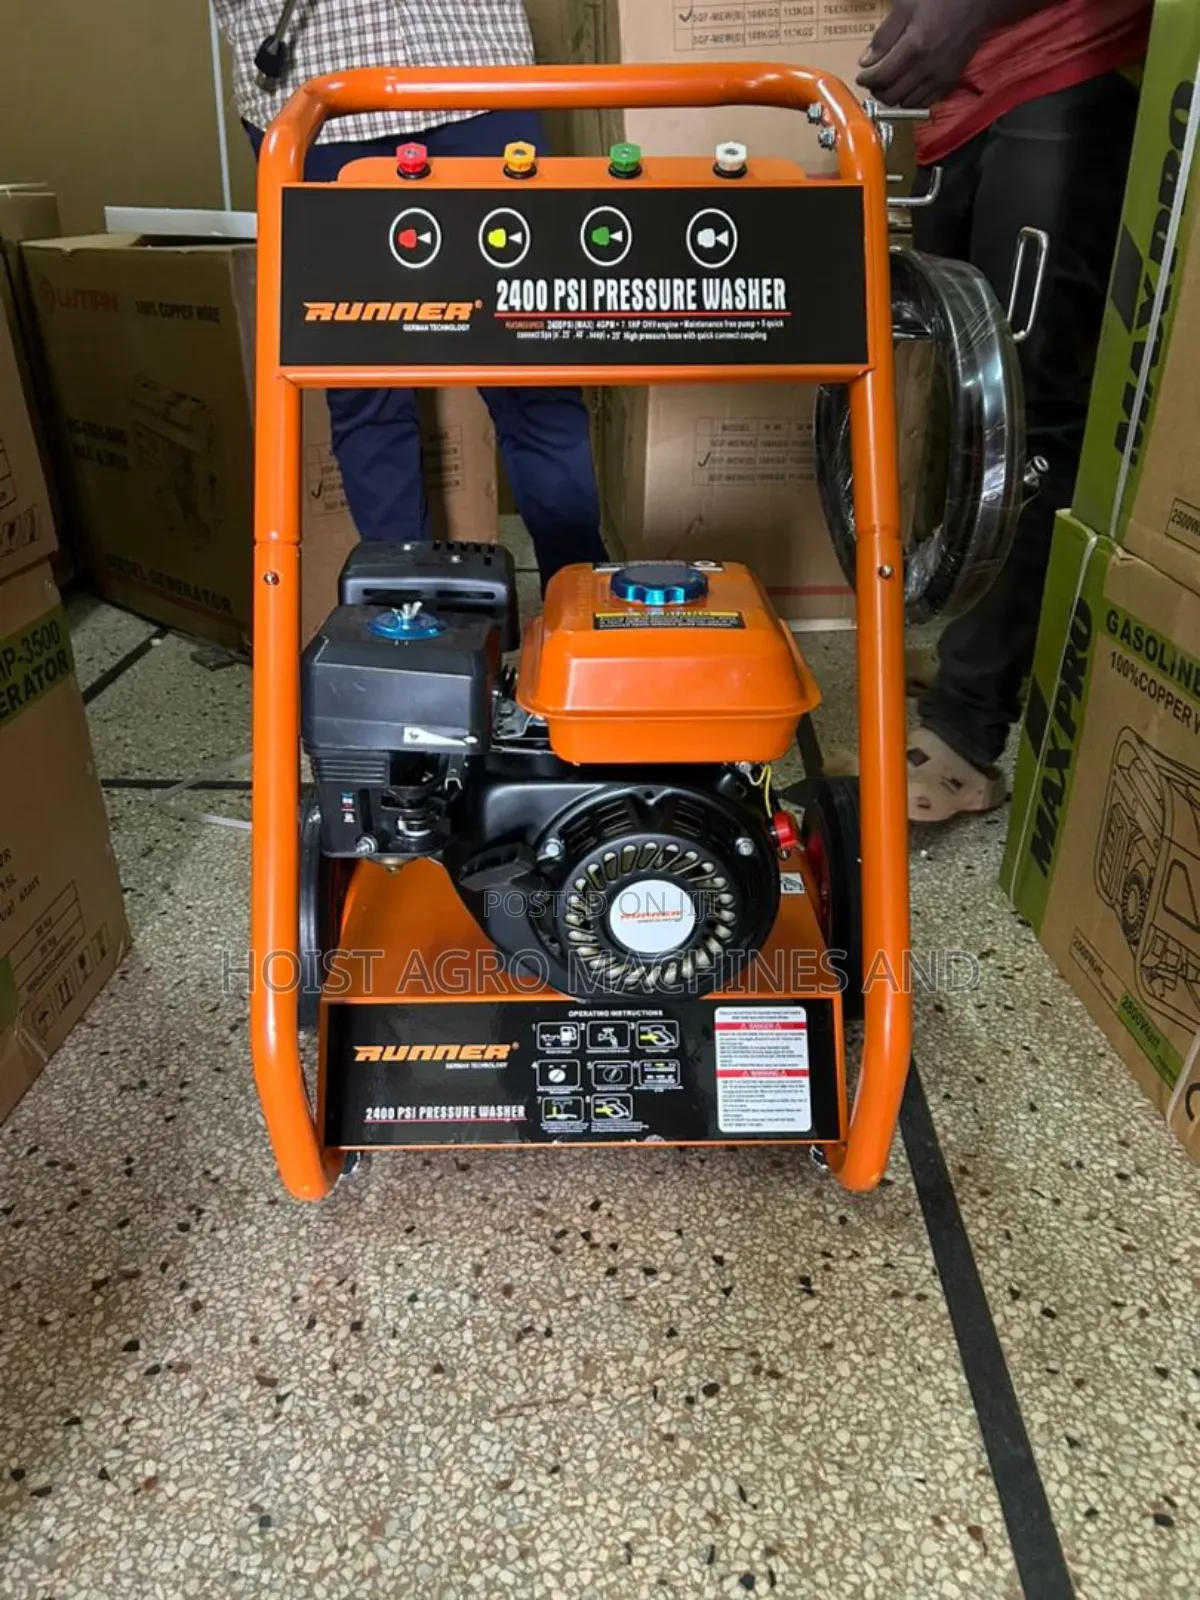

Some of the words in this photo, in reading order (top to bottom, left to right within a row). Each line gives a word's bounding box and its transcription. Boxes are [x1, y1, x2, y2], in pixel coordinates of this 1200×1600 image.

[496, 277, 548, 311] 2400
[553, 277, 587, 311] PSI
[593, 277, 698, 311] PRESSURE
[701, 277, 787, 310] WASHER
[430, 323, 471, 332] TECHNOLOGY
[149, 568, 233, 616] GENERATOR
[1030, 597, 1093, 879] MAXPRO
[568, 1010, 610, 1018] OPERATING
[610, 1009, 664, 1017] INSTRUCTIONS
[354, 1043, 511, 1062] RUNNER
[365, 1107, 395, 1121] 2400
[397, 1106, 417, 1120] PSI
[418, 1105, 477, 1119] PRESSURE
[478, 1104, 526, 1119] WASHER
